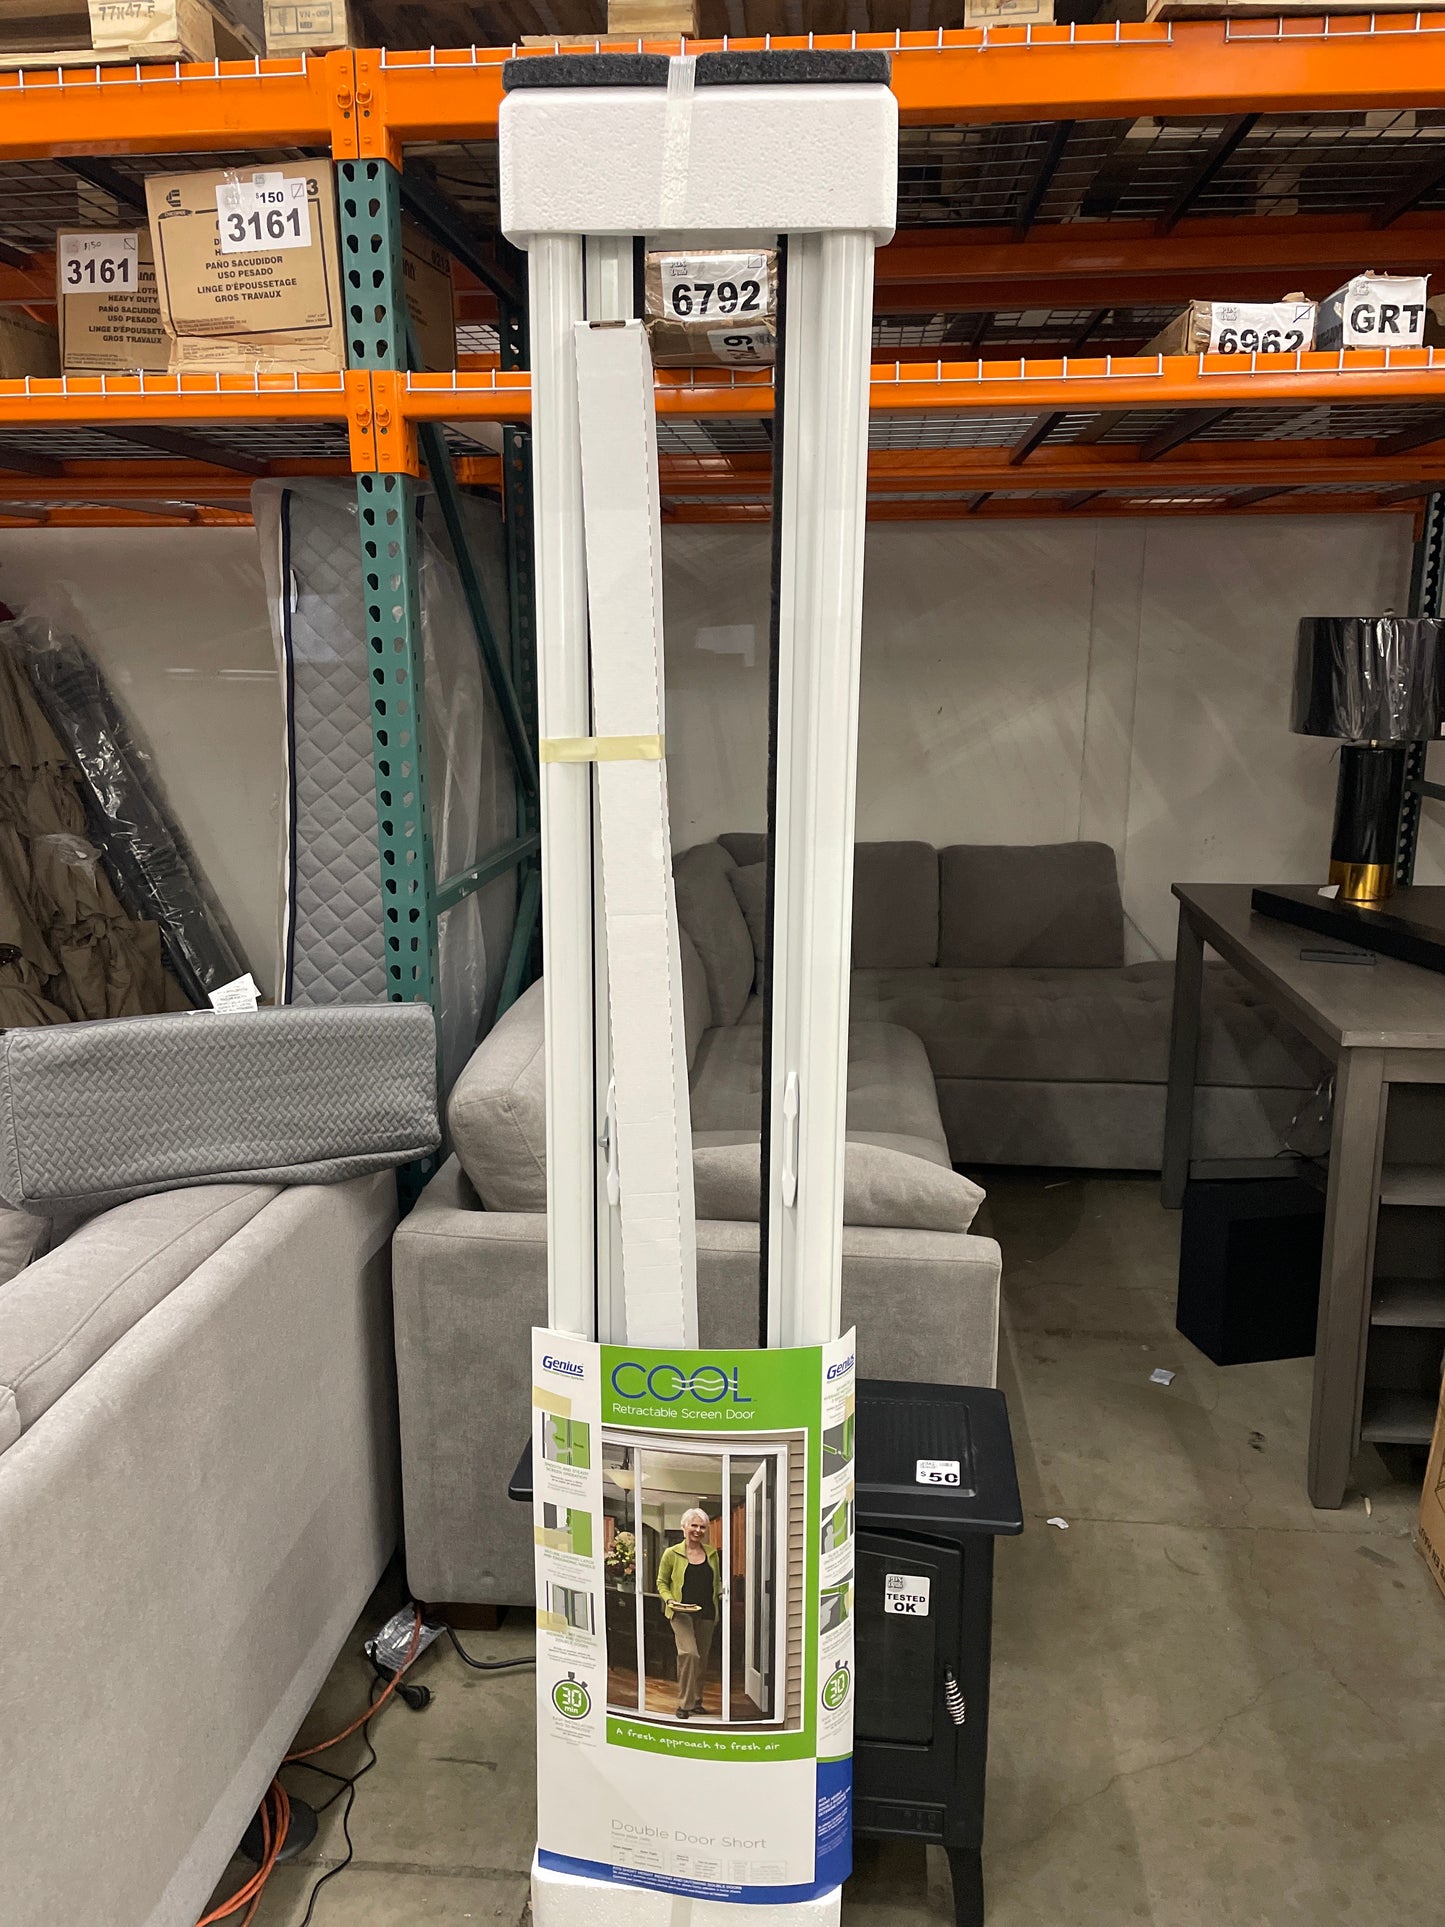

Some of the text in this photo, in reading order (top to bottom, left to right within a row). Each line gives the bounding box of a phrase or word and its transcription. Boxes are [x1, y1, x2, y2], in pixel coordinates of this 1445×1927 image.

[255, 191, 285, 204] $150
[226, 206, 302, 243] 3161
[66, 257, 130, 285] 3161
[205, 256, 284, 270] PAÑO SACUDIDOR
[217, 267, 274, 280] USO PESADO
[197, 277, 298, 294] LINGE D'ÉPOUSSETAGE
[214, 289, 283, 303] GROS TRAVAUX
[671, 279, 761, 316] 6792
[98, 304, 161, 315] PAÑO SACUDIDO
[107, 314, 158, 324] USO PESADO
[1350, 303, 1425, 334] GRT
[88, 325, 168, 335] LINGE D'ÉPOUSSETA
[102, 334, 162, 344] GROS TRAVAUX
[1217, 327, 1305, 355] 6962
[542, 1355, 584, 1374] Genius
[611, 1361, 752, 1404] COOL
[612, 1402, 756, 1420] Retractable Screen Door
[886, 1593, 926, 1603] TESTED
[894, 1602, 917, 1613] OK
[830, 1673, 845, 1699] 30
[561, 1686, 582, 1708] 30
[564, 1705, 579, 1715] min
[616, 1727, 781, 1751] A fresh approach to fresh air
[611, 1818, 670, 1840] Double
[674, 1830, 716, 1846] Door
[721, 1836, 768, 1849] Short
